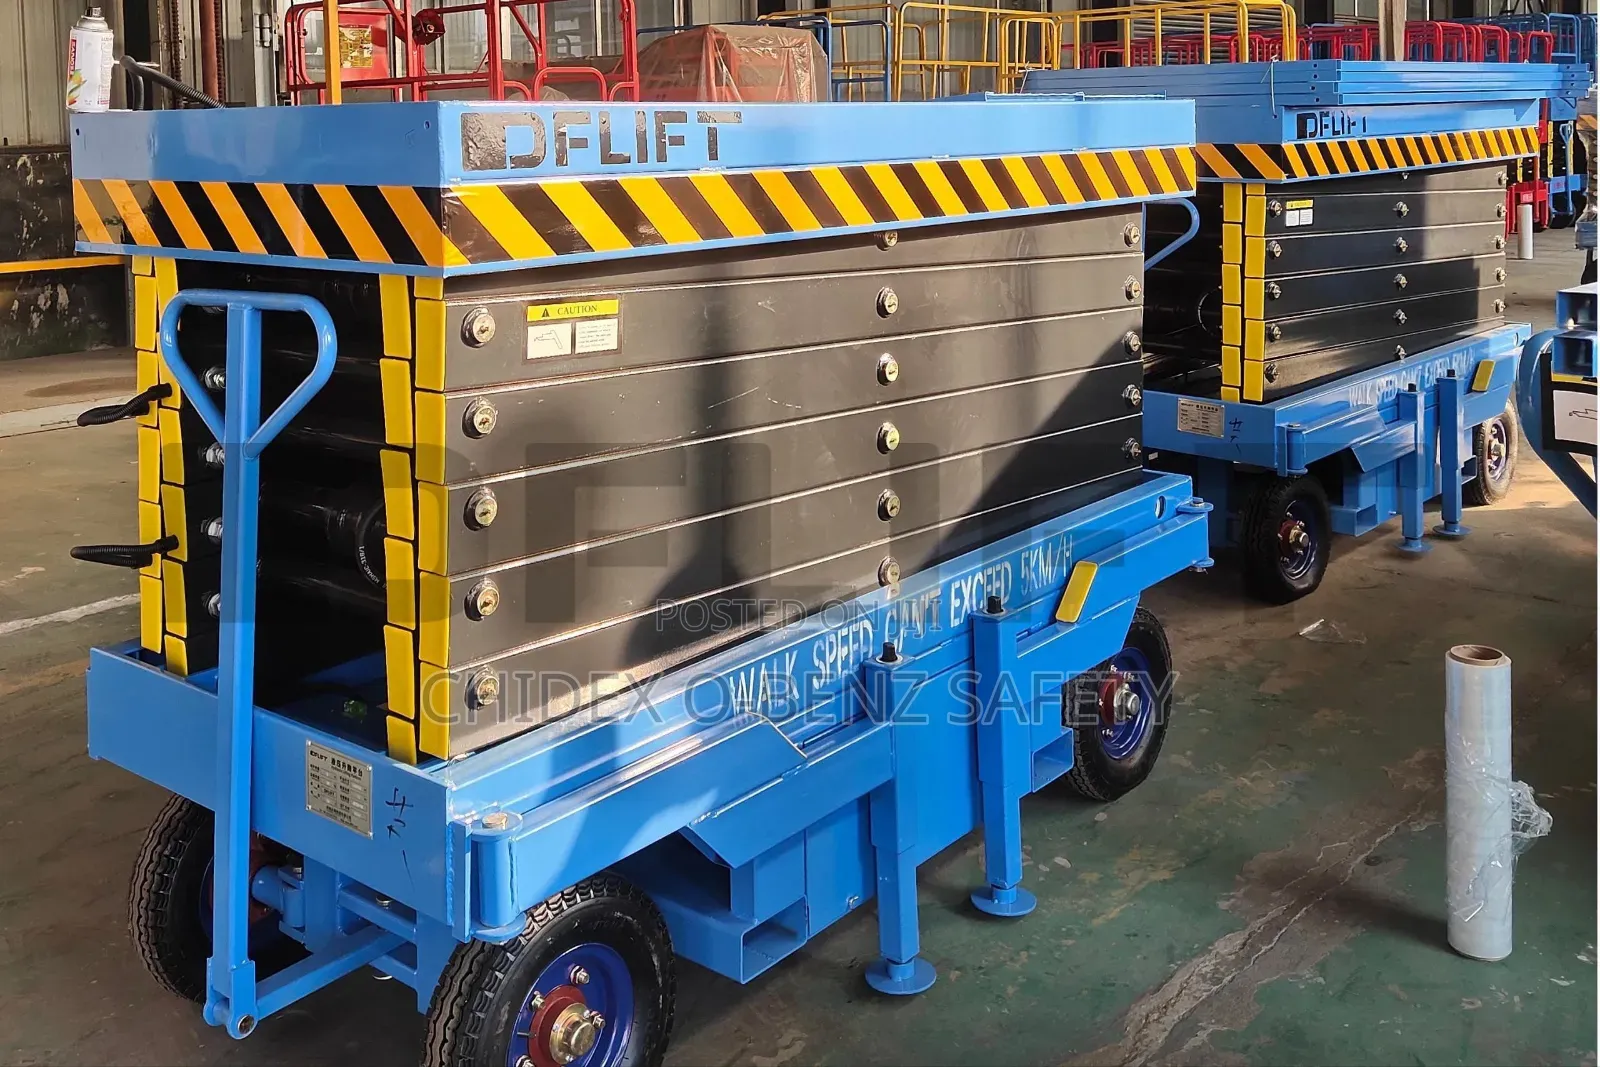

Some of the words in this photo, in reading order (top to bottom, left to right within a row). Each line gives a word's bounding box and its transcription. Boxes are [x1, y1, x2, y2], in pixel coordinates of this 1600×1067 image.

[461, 110, 742, 171] DFLIFT
[557, 304, 598, 316] CAUTION
[729, 650, 800, 717] WALK
[812, 619, 874, 690] SPEED
[950, 560, 1012, 629] EXCEED
[1020, 532, 1073, 596] 5KM/H
